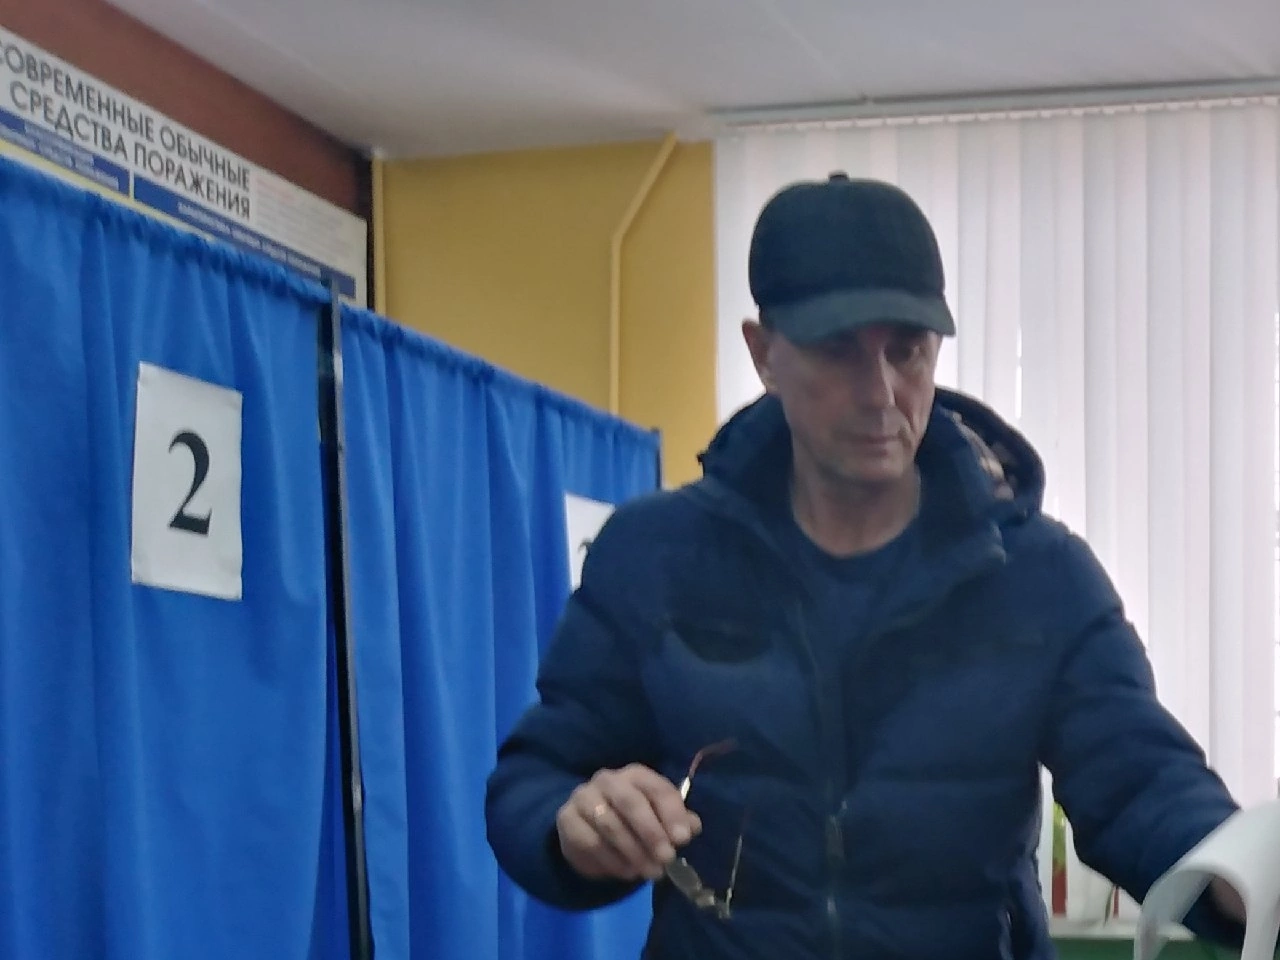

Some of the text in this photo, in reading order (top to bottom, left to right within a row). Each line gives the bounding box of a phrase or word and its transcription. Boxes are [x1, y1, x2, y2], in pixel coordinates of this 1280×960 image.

[10, 80, 128, 161] СРЕДСТВА
[134, 142, 250, 221] ПОРАЖЕНИЯ
[160, 125, 250, 193] ОБЫЧНЫЕ
[168, 430, 213, 536] 2
